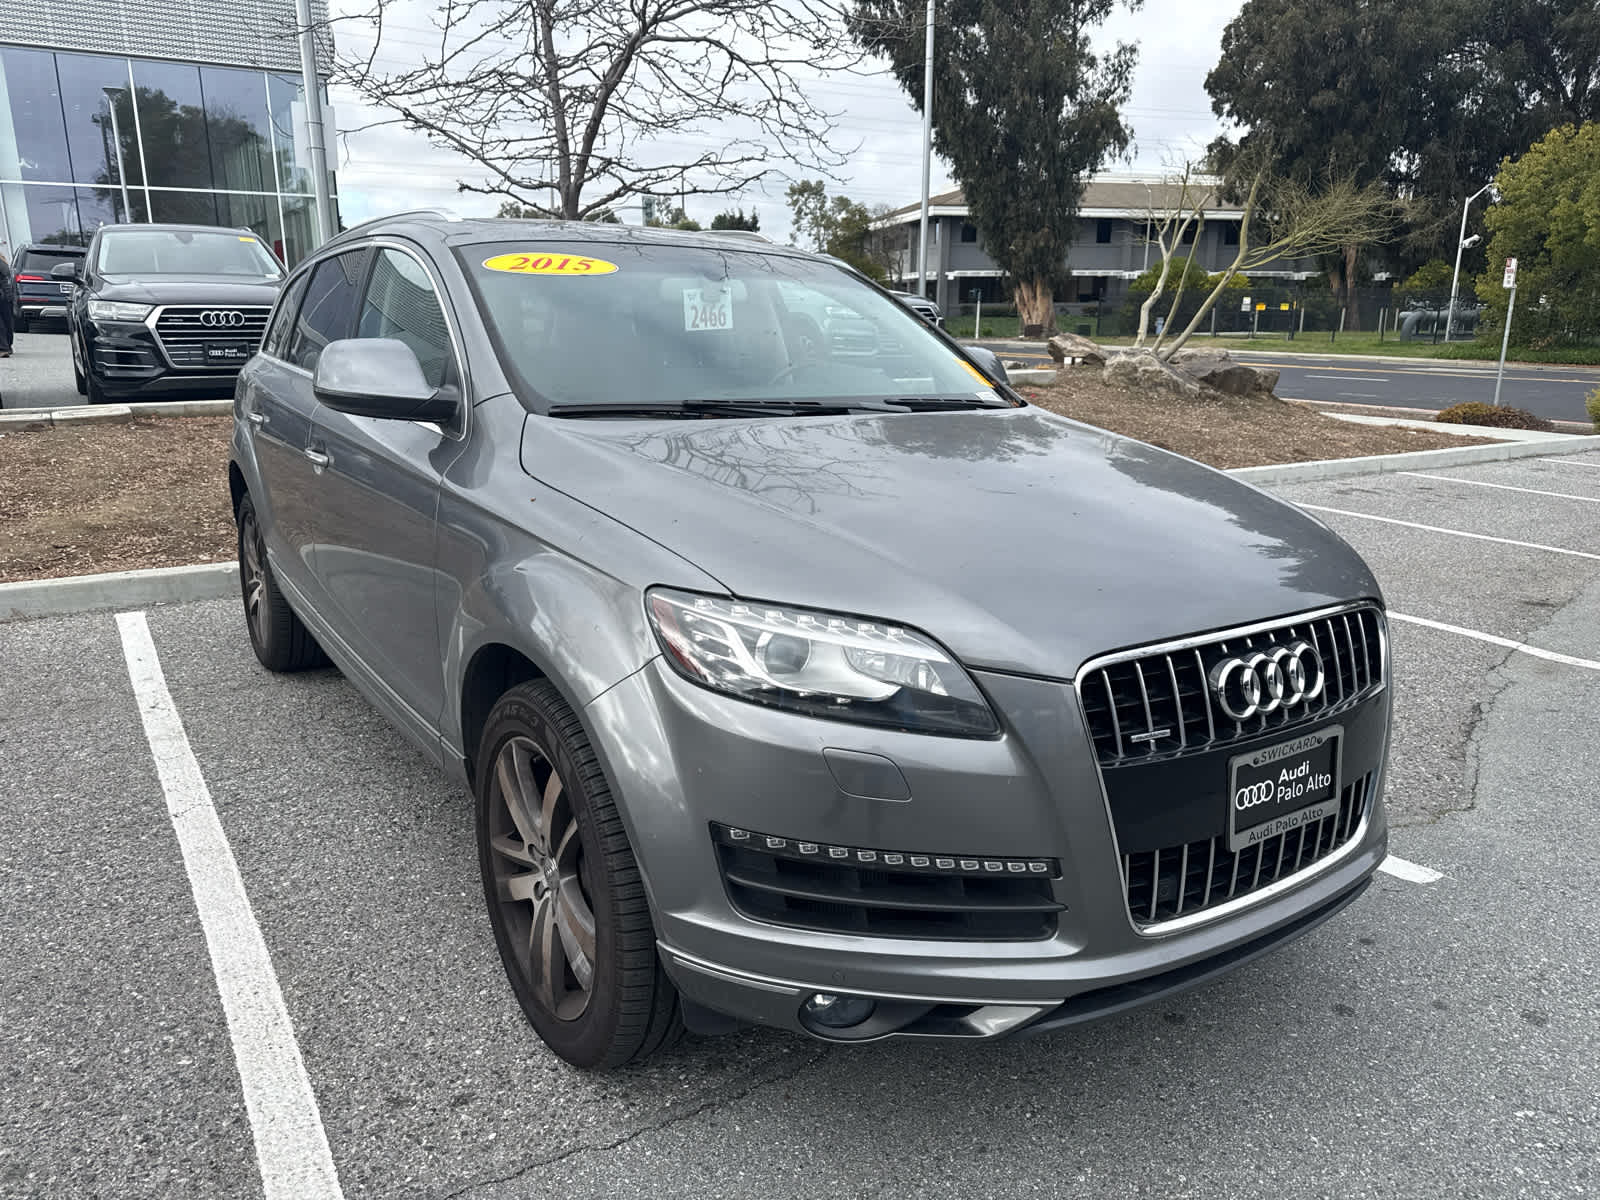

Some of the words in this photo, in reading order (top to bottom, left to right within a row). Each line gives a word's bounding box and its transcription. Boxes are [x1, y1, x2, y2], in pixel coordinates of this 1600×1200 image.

[509, 257, 595, 271] 2015
[690, 303, 726, 328] 2466
[1261, 735, 1317, 763] SWICKARD
[1278, 760, 1310, 784] Audi
[1277, 781, 1303, 804] Palo
[1306, 773, 1331, 793] Alto
[1248, 824, 1273, 844] Audi
[1276, 816, 1298, 833] Palo
[1301, 808, 1323, 823] Alto
